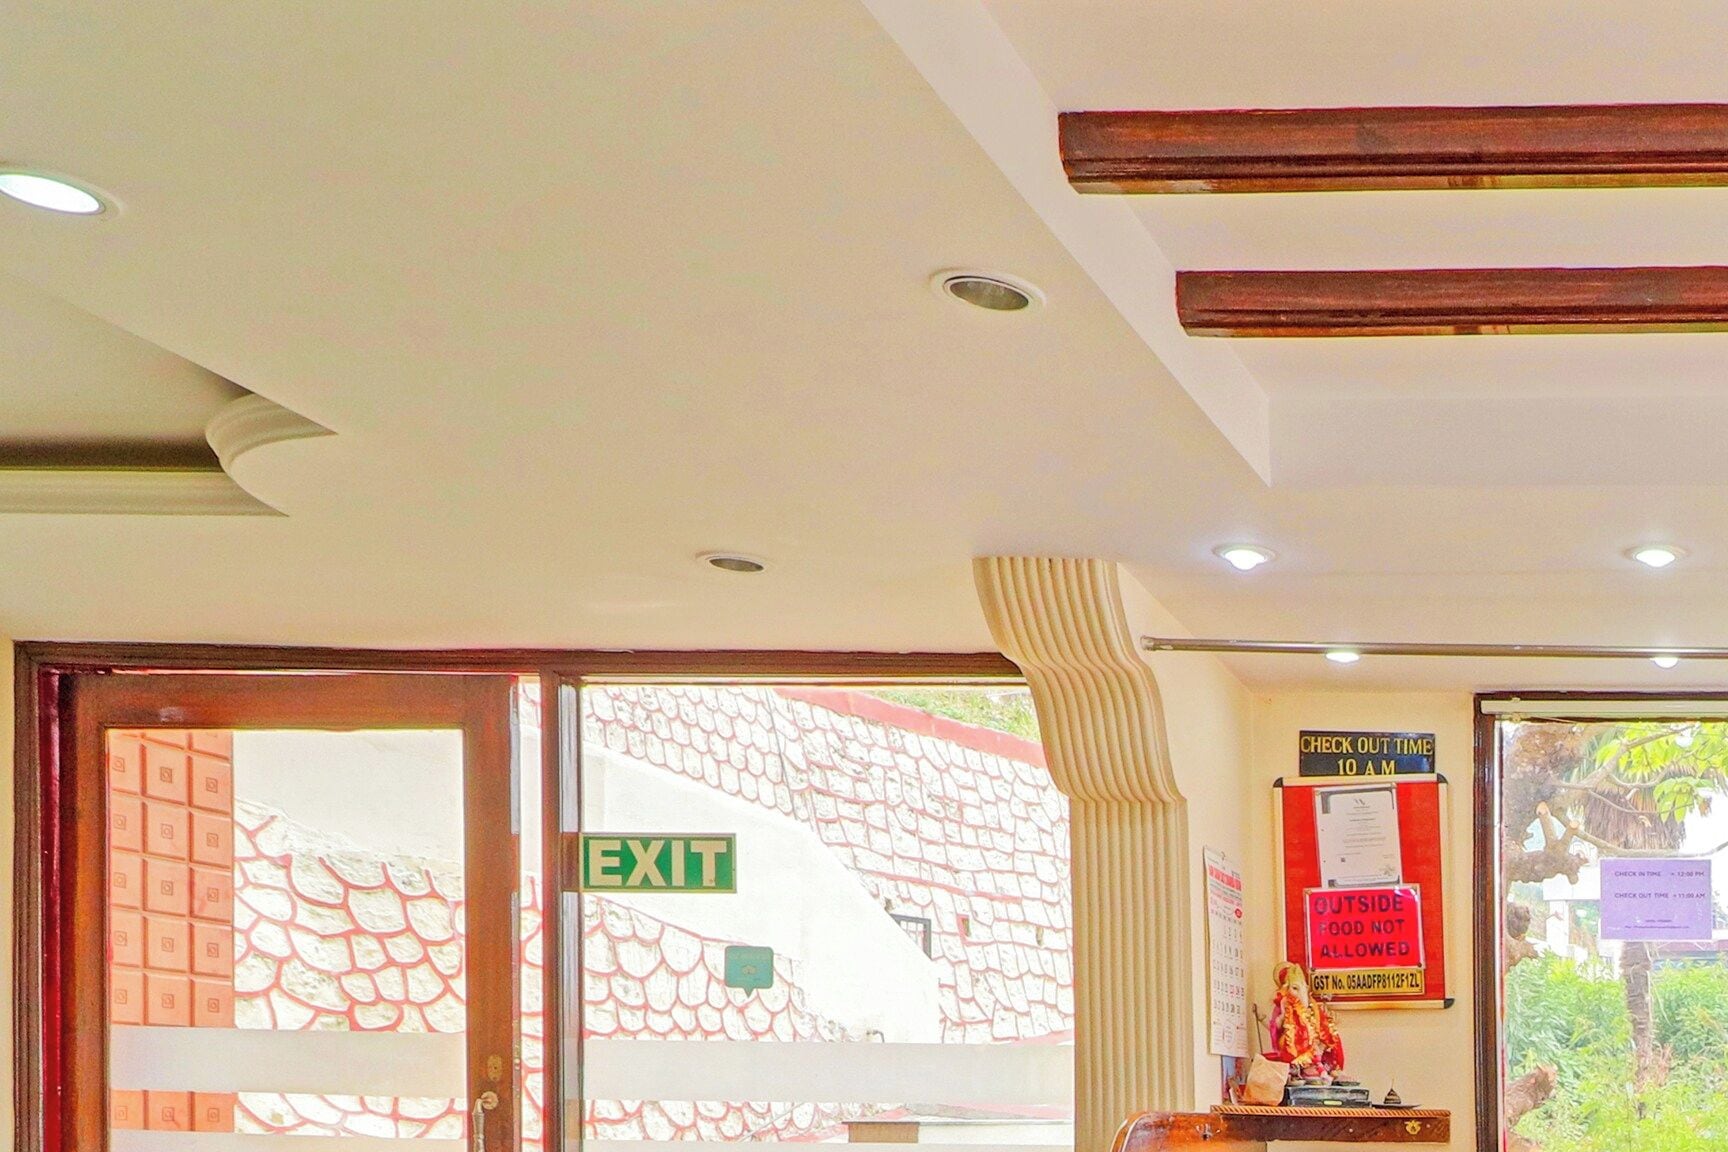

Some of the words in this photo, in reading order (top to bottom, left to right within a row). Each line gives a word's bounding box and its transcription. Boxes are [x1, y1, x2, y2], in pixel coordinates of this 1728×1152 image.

[1301, 736, 1353, 753] CHECK
[1358, 737, 1390, 754] OUT
[1394, 738, 1433, 755] TIME
[1338, 758, 1356, 775] 10
[588, 839, 727, 887] EXIT
[1314, 894, 1404, 915] OUTSIDE
[1320, 921, 1364, 936] FOOD
[1371, 918, 1405, 934] NOT
[1320, 941, 1410, 958] ALLOWED
[1313, 975, 1330, 990] GST
[1332, 975, 1345, 990] No.
